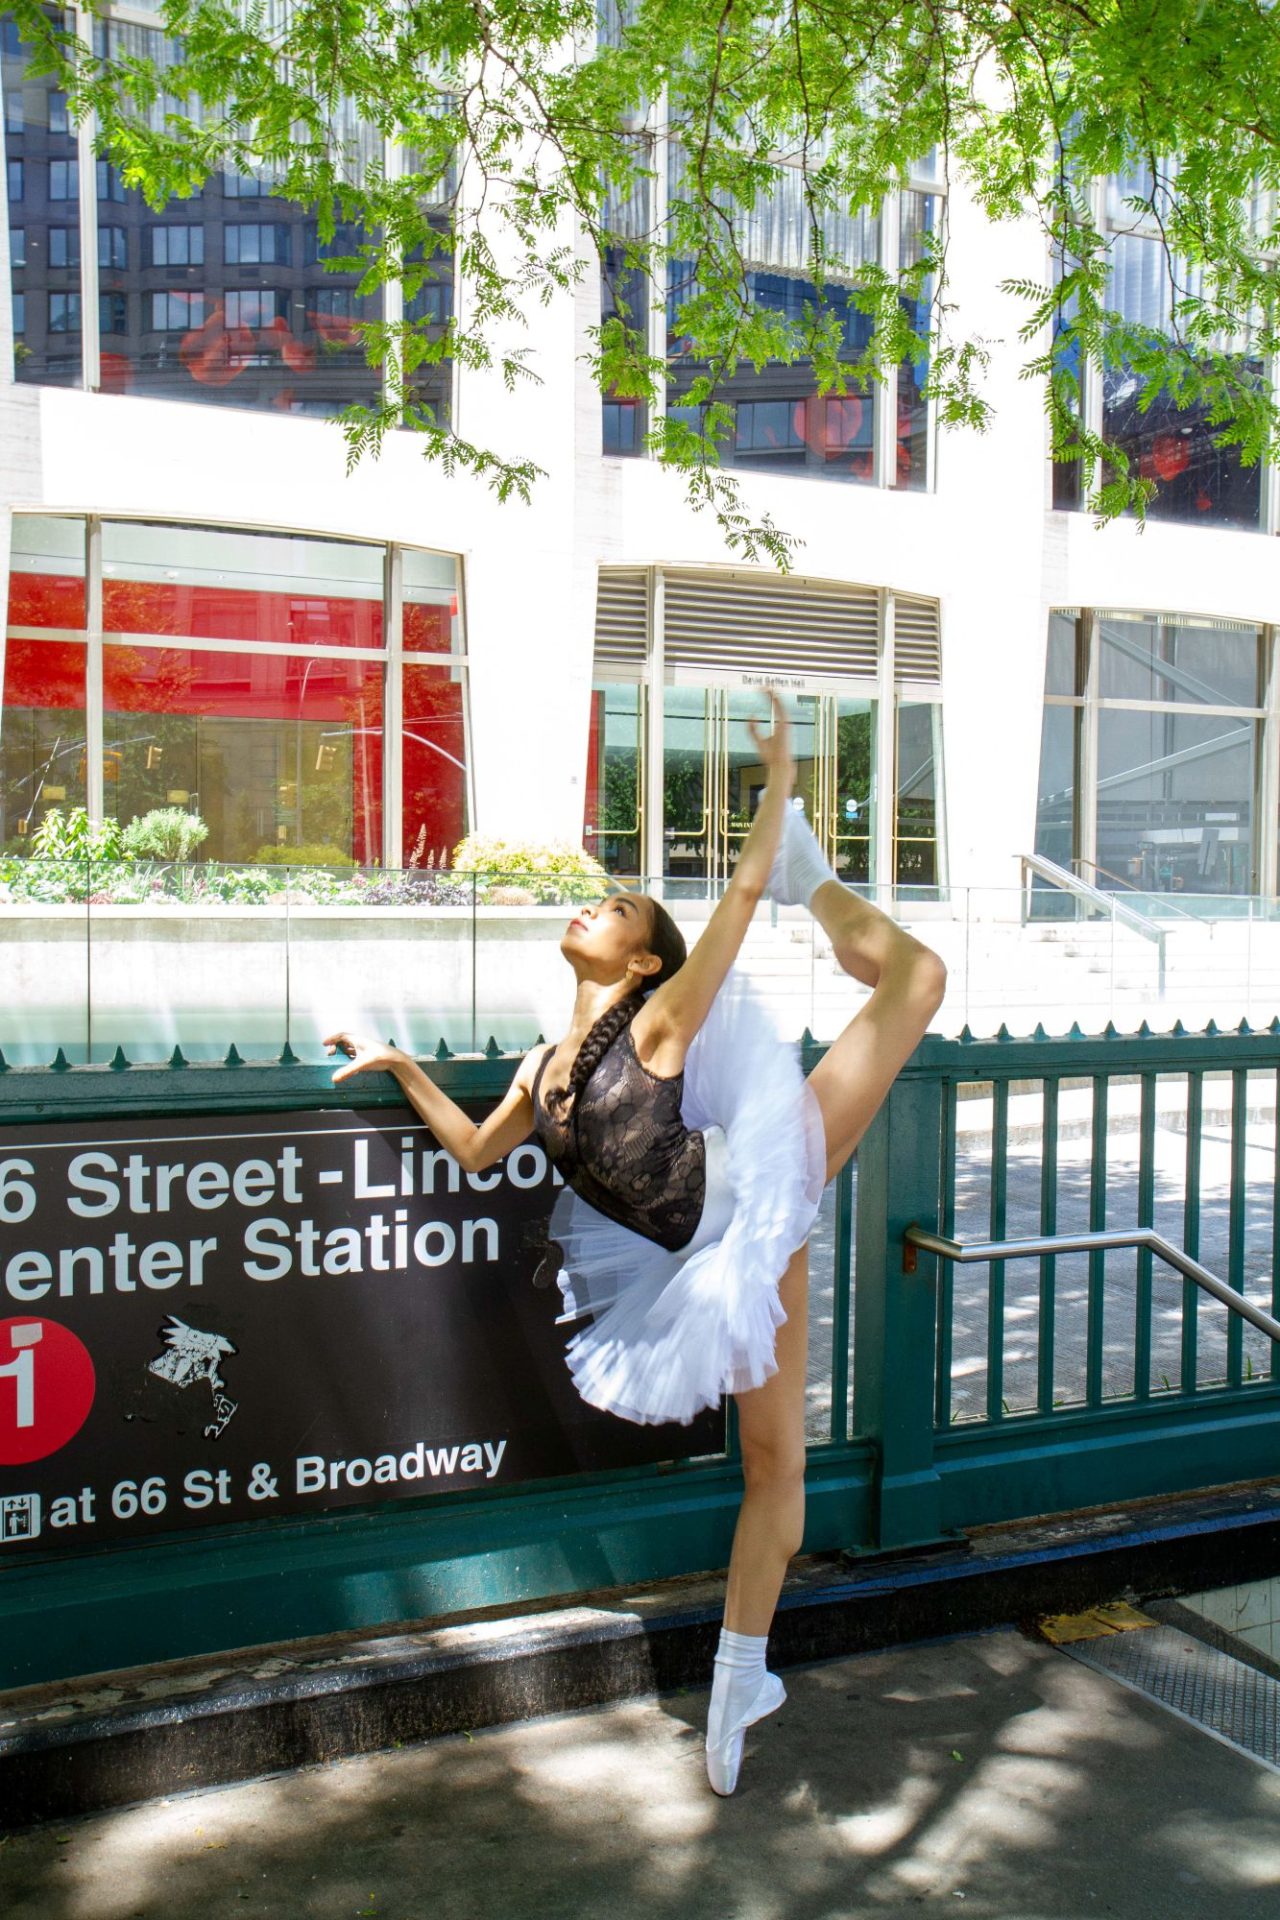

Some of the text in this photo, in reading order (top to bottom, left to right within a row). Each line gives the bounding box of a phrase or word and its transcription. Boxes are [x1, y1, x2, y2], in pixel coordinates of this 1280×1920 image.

[66, 1146, 303, 1218] Street
[243, 1209, 499, 1281] Station
[50, 1440, 507, 1528] at 66 St & Broadway
